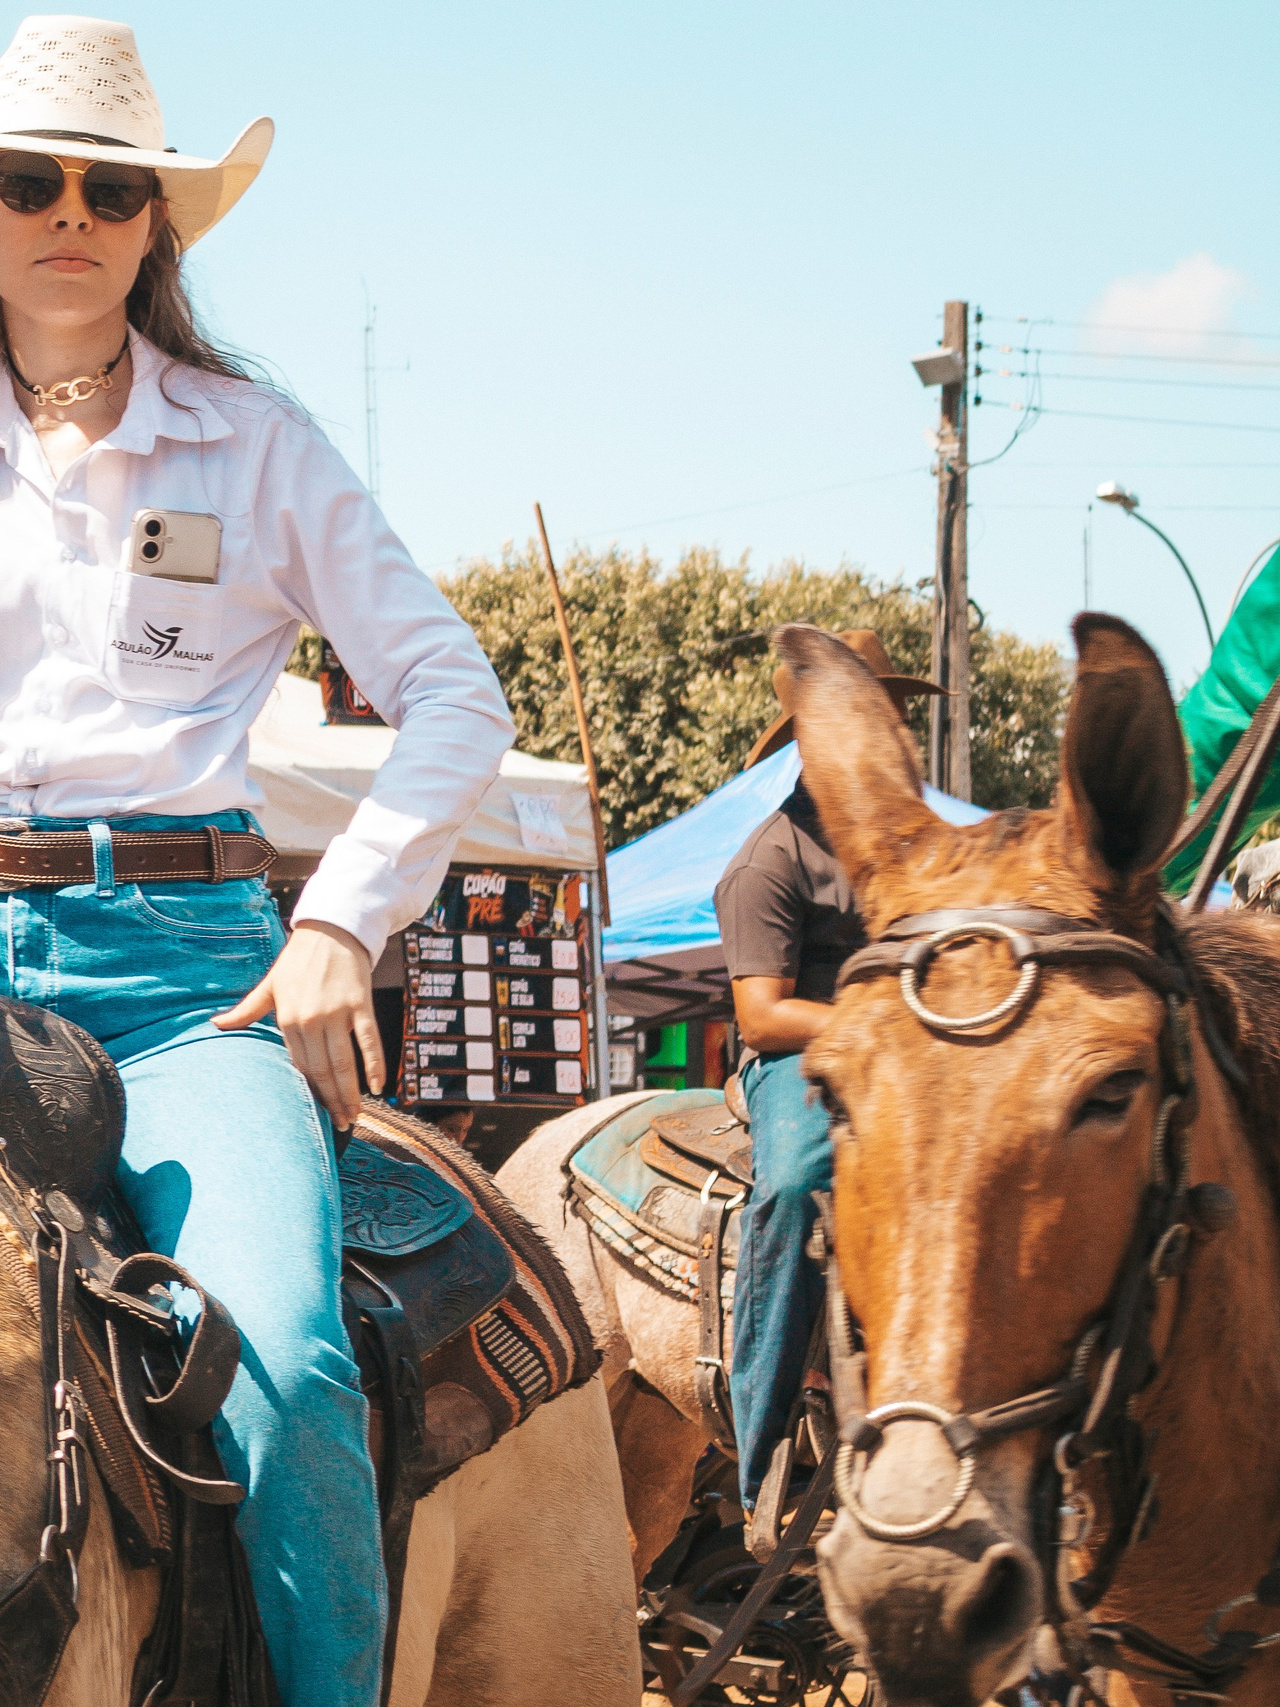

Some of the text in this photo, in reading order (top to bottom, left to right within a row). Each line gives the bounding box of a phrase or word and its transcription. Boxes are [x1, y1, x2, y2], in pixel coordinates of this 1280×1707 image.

[111, 640, 214, 661] AZULÃO MALHAS
[463, 873, 507, 898] COPÃO
